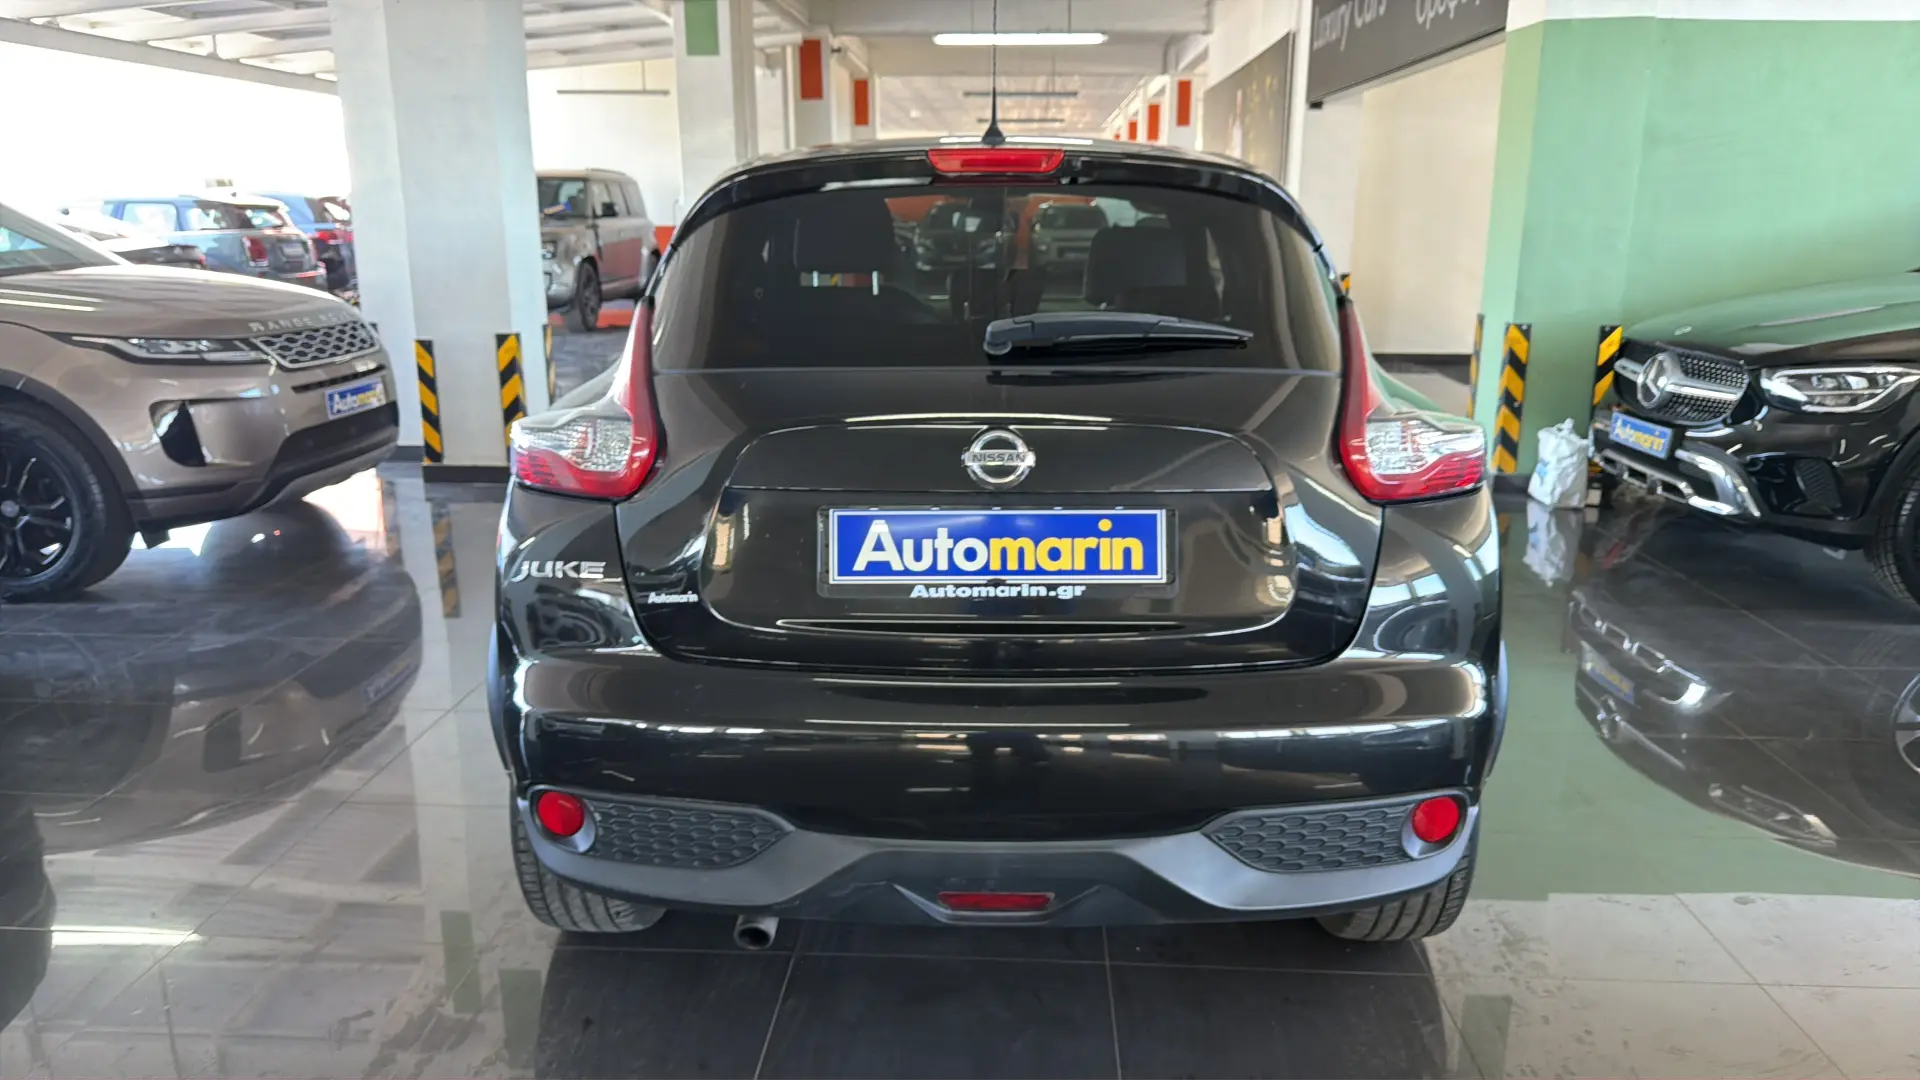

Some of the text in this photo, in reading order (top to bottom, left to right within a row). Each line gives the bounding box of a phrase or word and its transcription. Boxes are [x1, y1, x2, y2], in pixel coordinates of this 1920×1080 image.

[1312, 1, 1353, 52] Luxury
[971, 452, 1026, 464] NISSAN
[852, 518, 1144, 572] Automarin
[510, 560, 606, 583] JUKE
[647, 590, 699, 604] Automarin
[909, 584, 1087, 600] Automarin.gr
